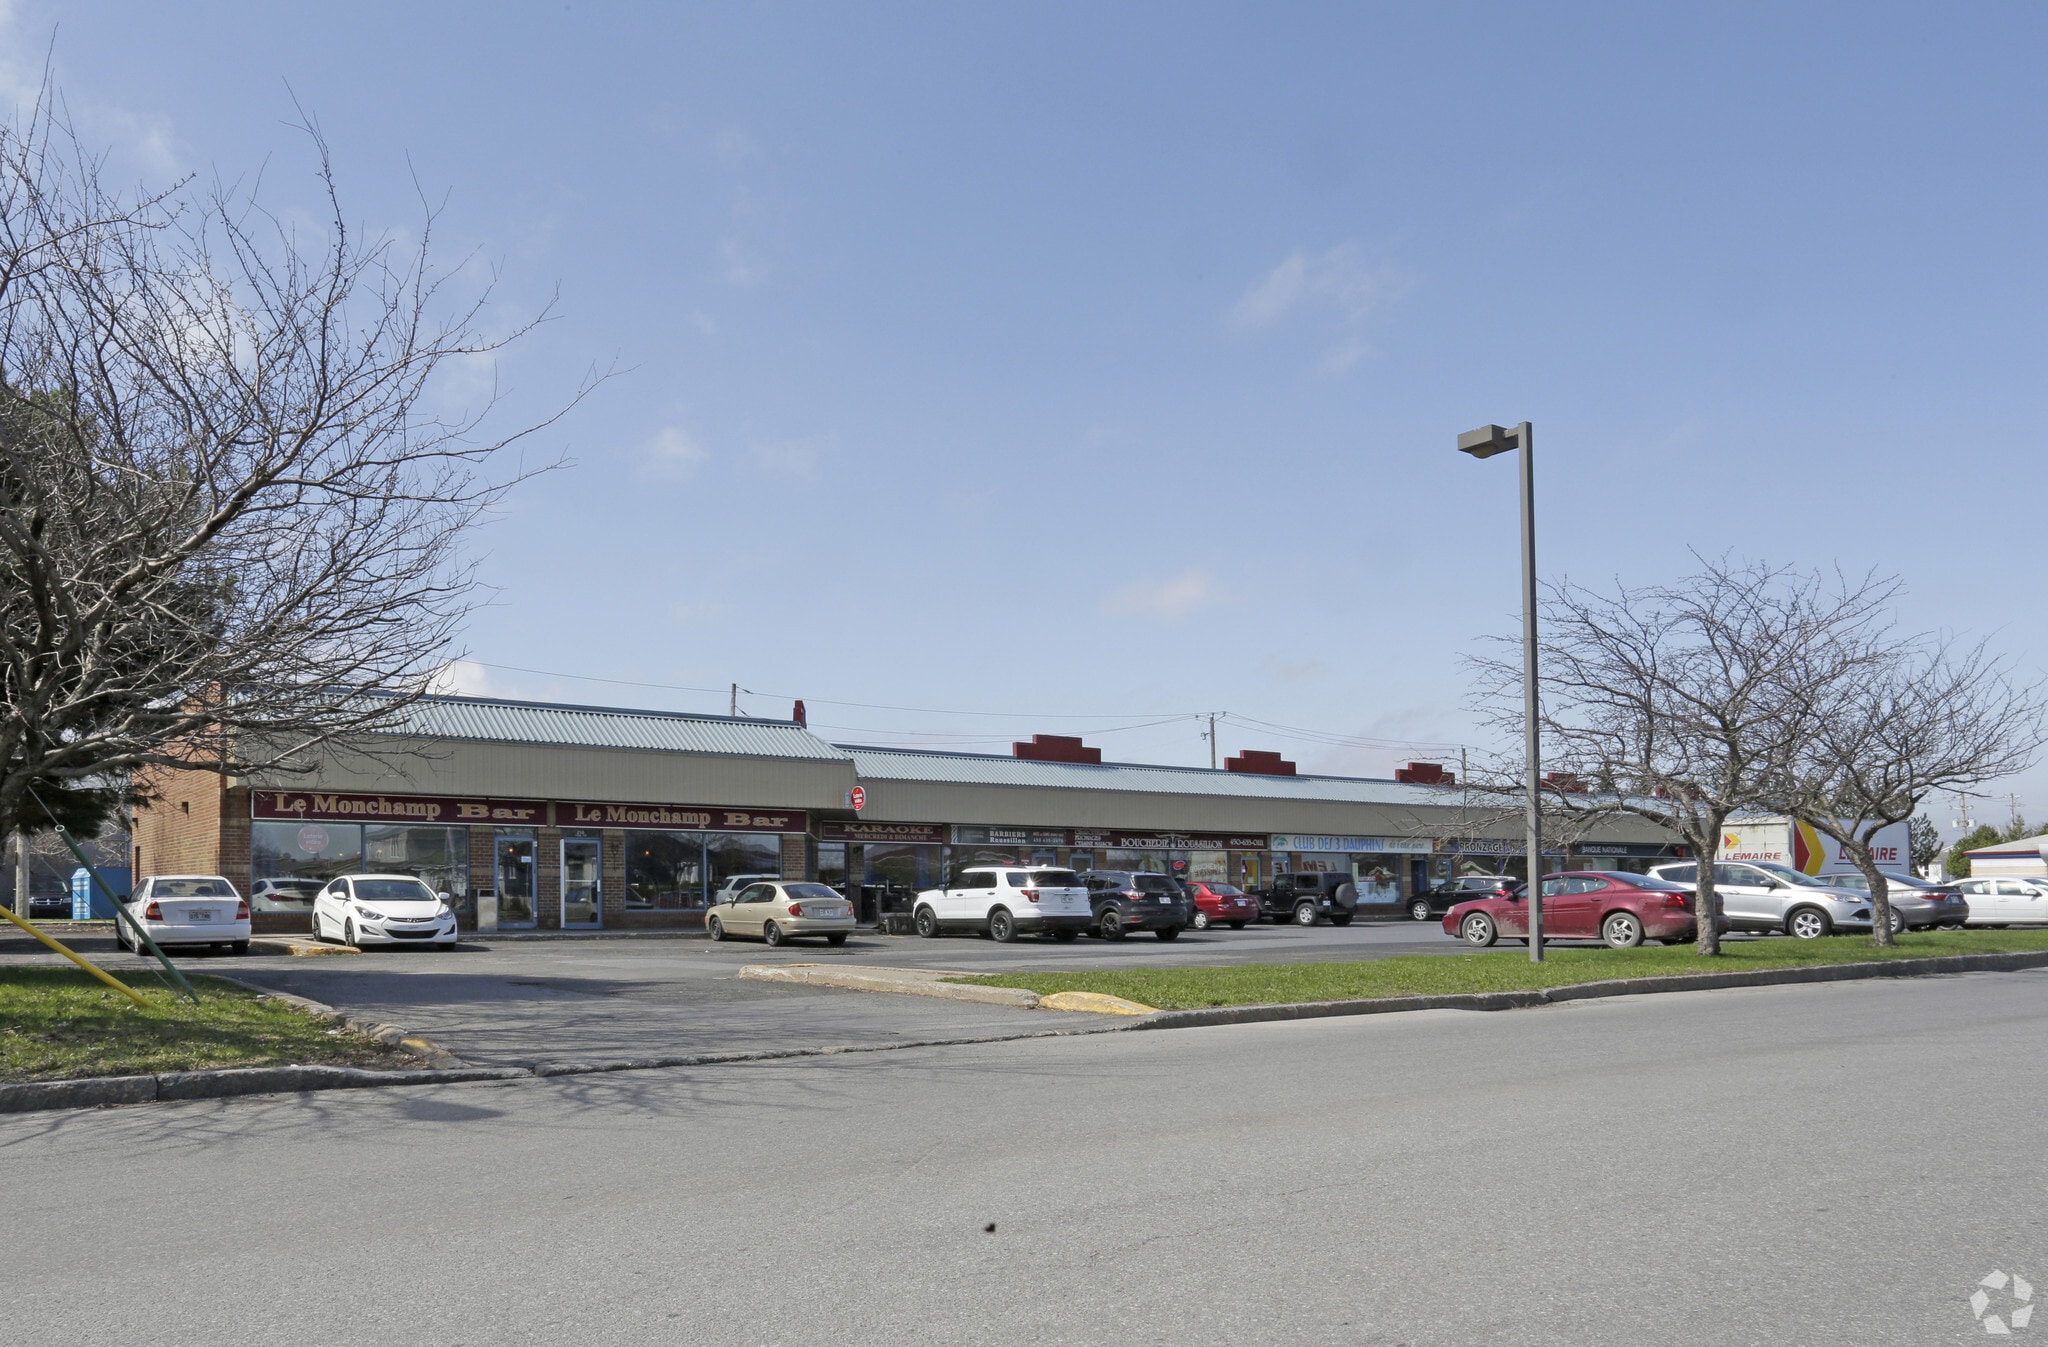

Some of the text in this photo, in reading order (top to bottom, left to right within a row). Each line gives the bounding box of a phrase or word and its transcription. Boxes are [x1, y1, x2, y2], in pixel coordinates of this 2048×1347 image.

[274, 793, 535, 821] Le Monchamp Bar
[575, 804, 788, 828] Le Monchamp Bar
[843, 823, 934, 834] KARAOKE
[989, 830, 1026, 838] BARBIERS
[1121, 838, 1223, 849] BOUCHERIE ROUSSILLON
[1293, 836, 1385, 851] CLUB DES 3 DAUPHINS
[1459, 841, 1503, 852] BRONZAGE
[1582, 845, 1628, 854] BANQUE NATIONALE
[1838, 847, 1898, 861] LAIRE
[1724, 852, 1782, 861] LEMAIRE
